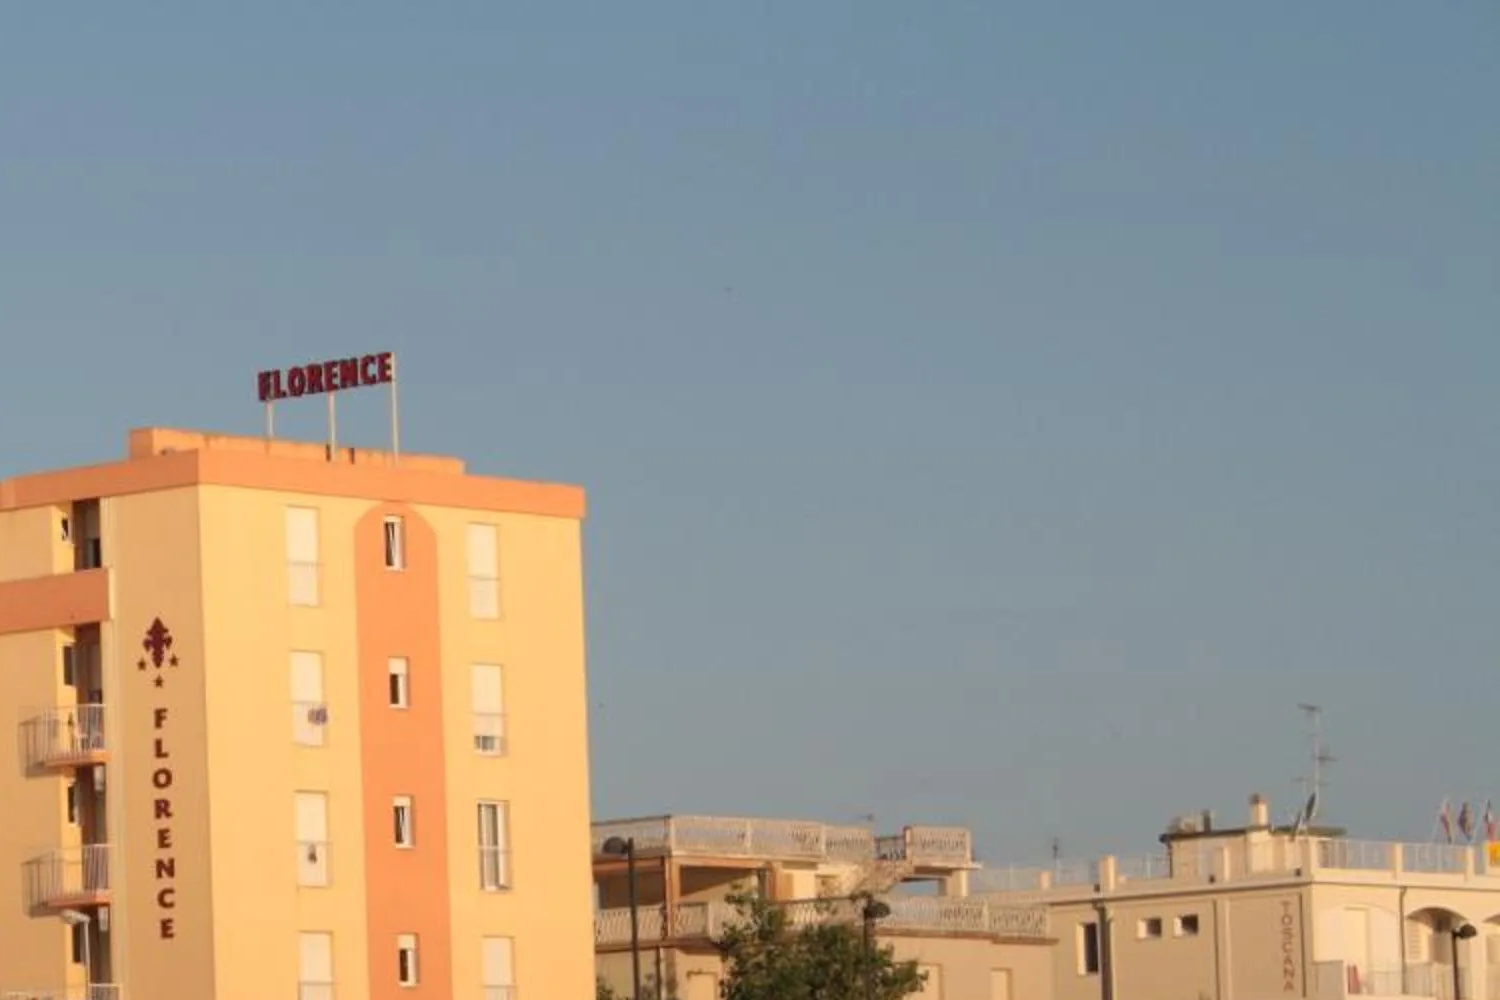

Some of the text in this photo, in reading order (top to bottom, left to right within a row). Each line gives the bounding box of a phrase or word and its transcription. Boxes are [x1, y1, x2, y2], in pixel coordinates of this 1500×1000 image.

[258, 352, 392, 402] FLORENCE
[152, 708, 175, 939] FLORENCE
[1281, 901, 1295, 992] TOSCANA
